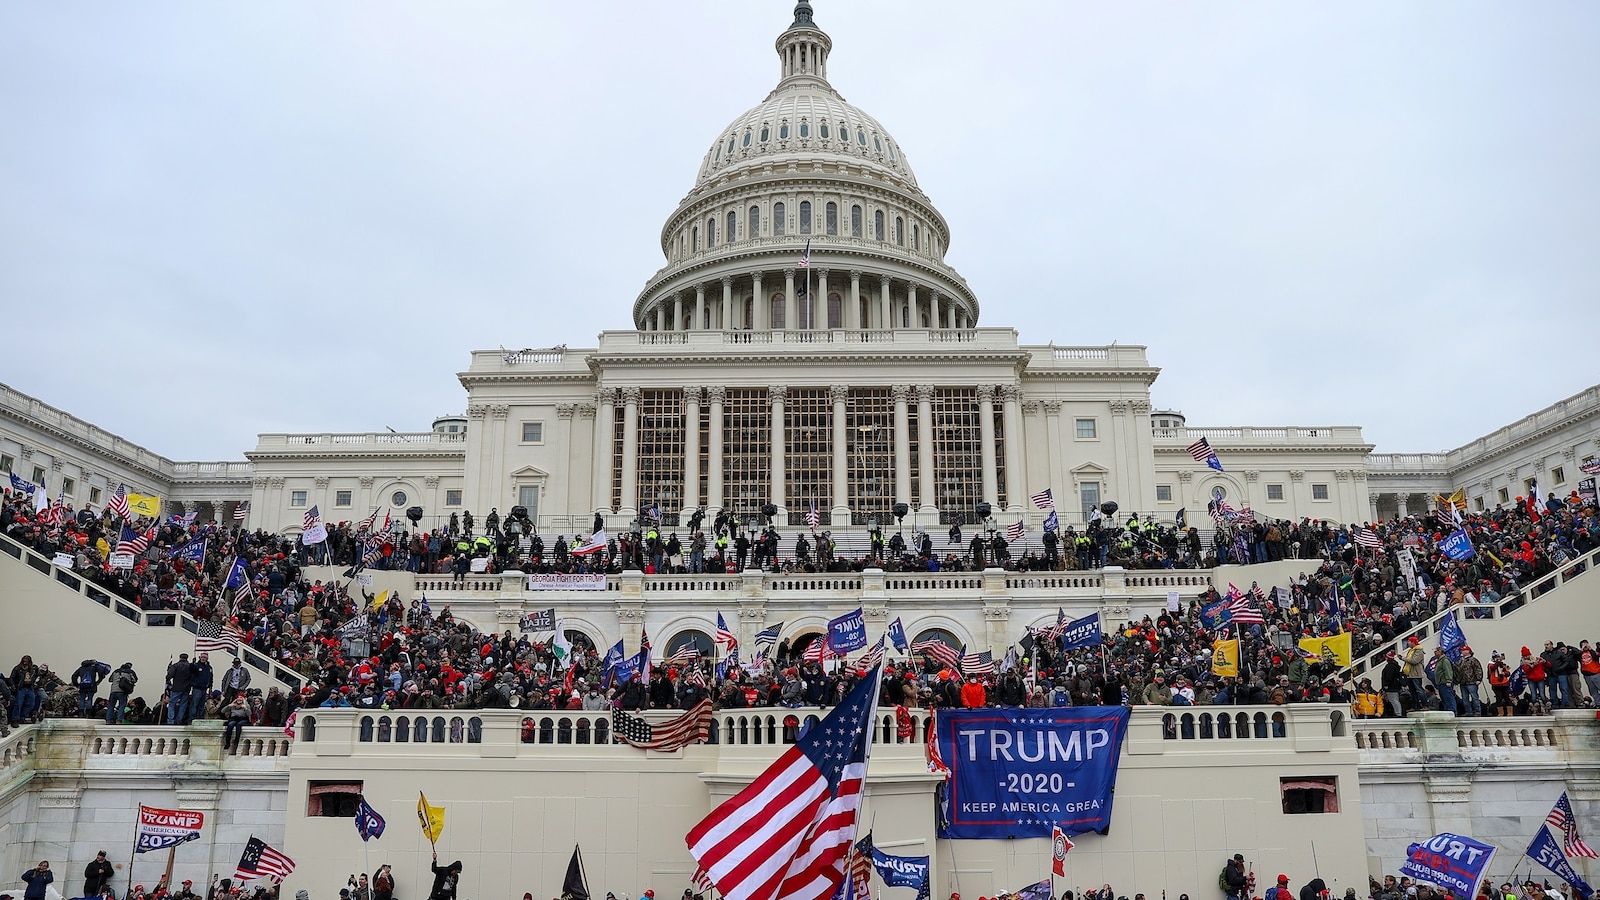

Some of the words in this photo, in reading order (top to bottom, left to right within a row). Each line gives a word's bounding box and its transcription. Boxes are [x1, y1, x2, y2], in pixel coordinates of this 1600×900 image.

[959, 729, 1109, 763] TRUMP
[962, 803, 997, 813] KEEP
[1001, 802, 1061, 813] AMERICA
[142, 811, 201, 827] TRUMP
